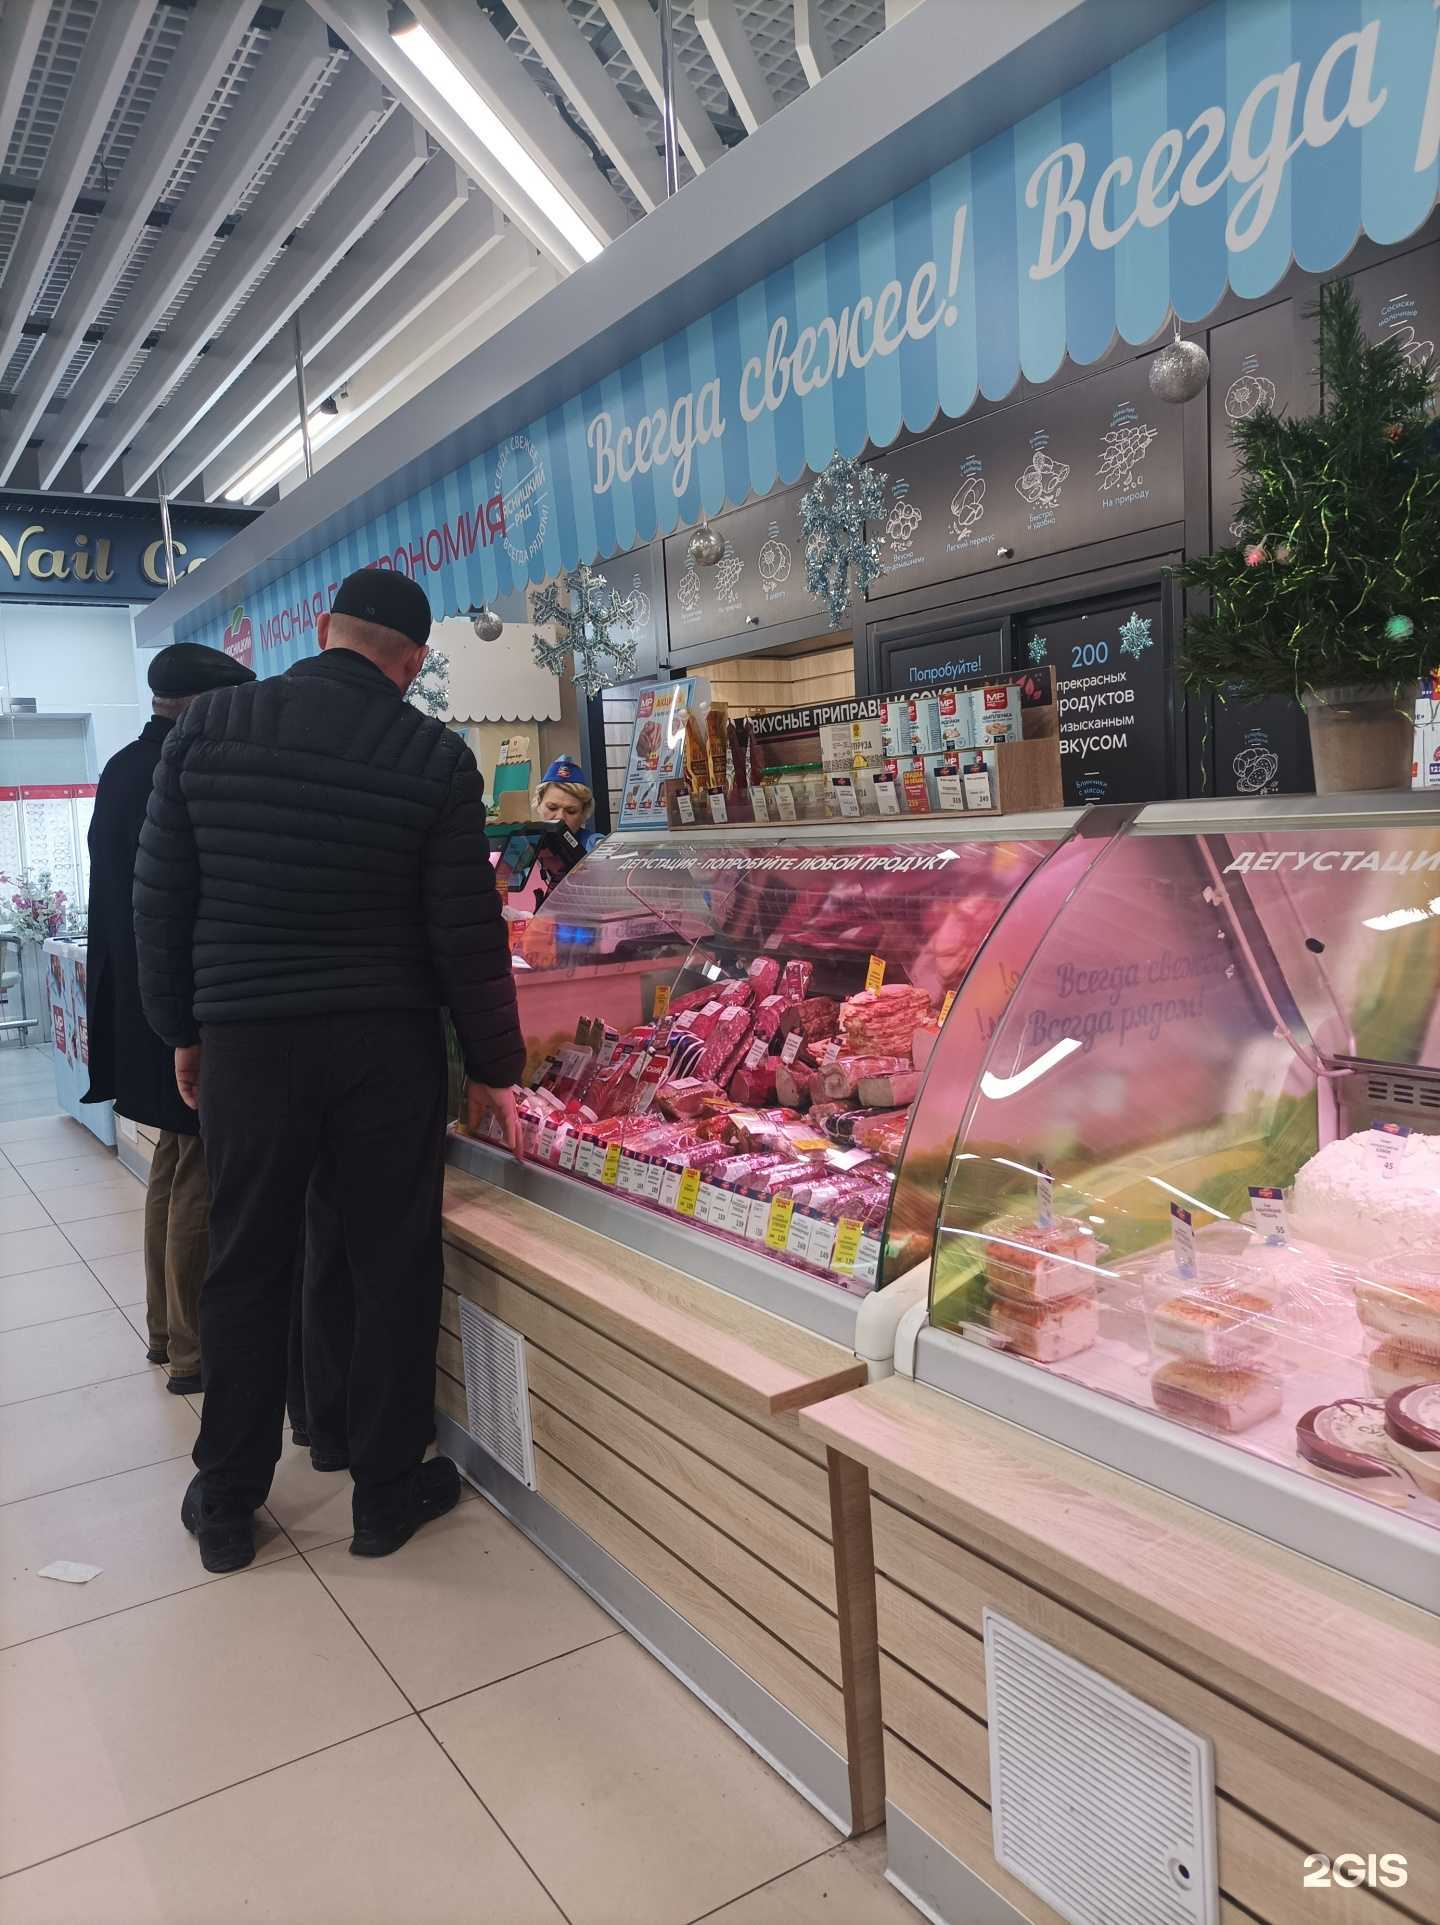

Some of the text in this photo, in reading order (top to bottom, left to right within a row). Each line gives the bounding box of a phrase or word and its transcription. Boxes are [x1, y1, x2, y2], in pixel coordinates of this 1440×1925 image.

[1025, 19, 1388, 281] Всегда
[587, 204, 968, 498] Всегда свежее!
[1115, 490, 1150, 505] природу
[514, 503, 533, 527] РЯД
[0, 526, 207, 585] Nail C
[260, 495, 506, 650] МЯСНАЯ ГОНОМИЯ
[1071, 642, 1108, 668] 200
[909, 655, 982, 683] Попробуйте!
[1056, 672, 1127, 694] прекрасных
[752, 712, 810, 735] ВКУСНЫЕ
[1060, 716, 1135, 733] изысканным
[617, 857, 698, 871] ДЕГУСТАЦИЯ
[701, 855, 798, 870] ПОПРОБУЙТЕ
[794, 854, 864, 871] ЛЮБОЙ
[1056, 961, 1140, 1005] Всегда
[1028, 1008, 1114, 1053] Всегда
